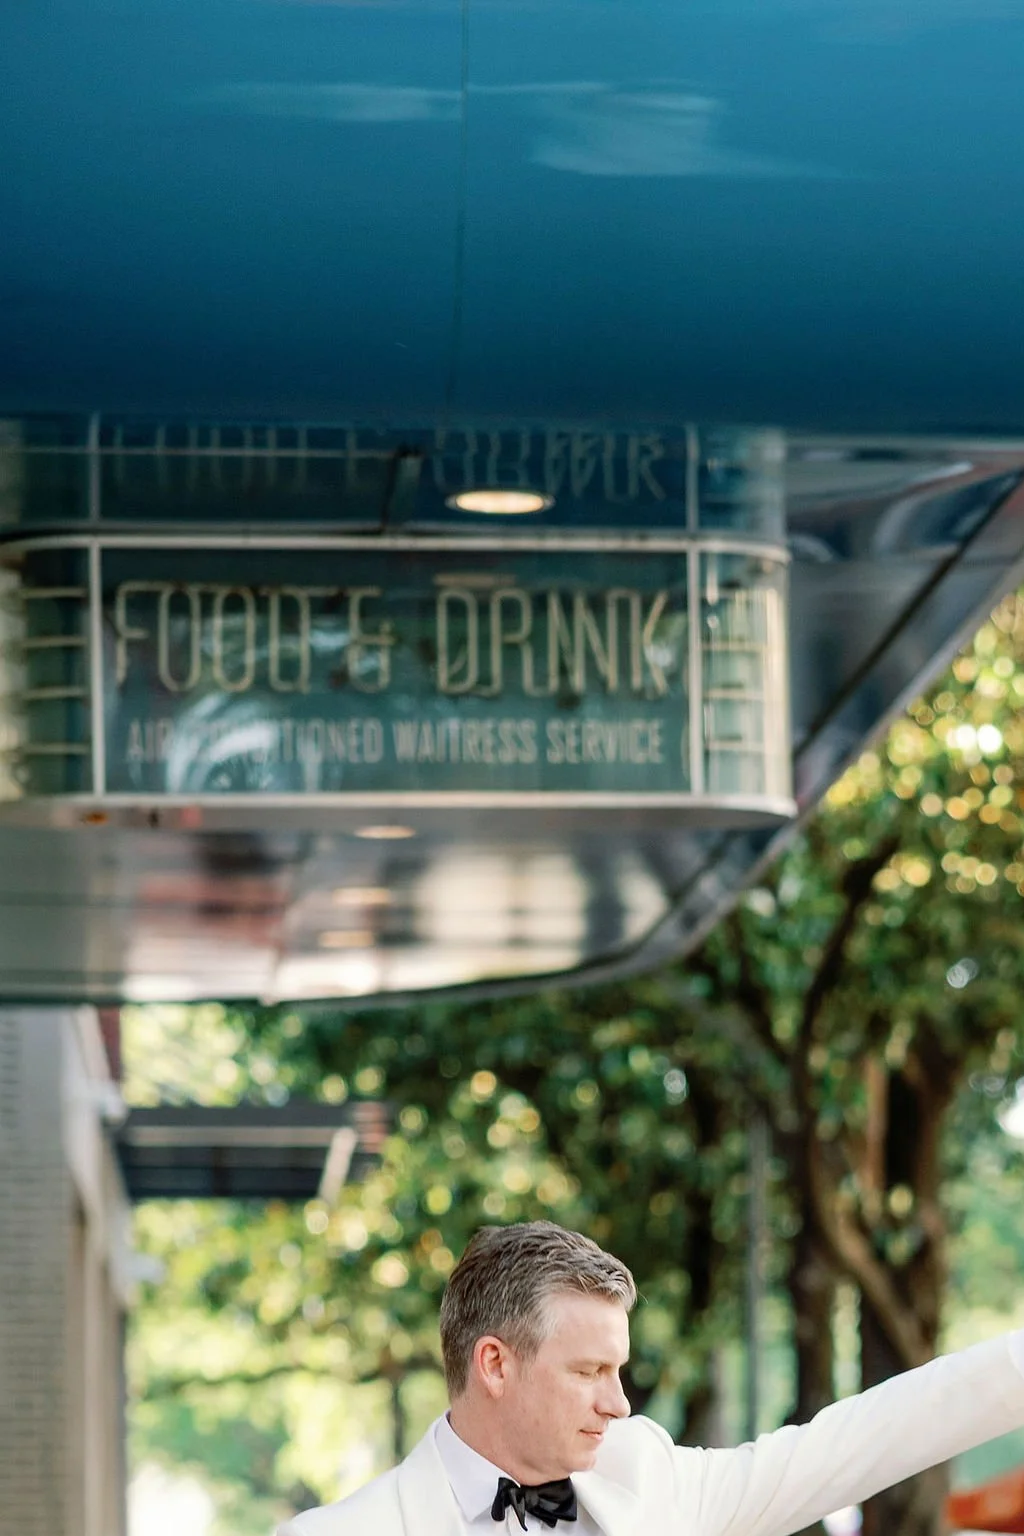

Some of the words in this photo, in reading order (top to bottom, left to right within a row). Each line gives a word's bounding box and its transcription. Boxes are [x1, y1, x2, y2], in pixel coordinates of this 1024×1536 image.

[115, 581, 312, 694] FOOD
[433, 576, 669, 697] DRINK
[392, 717, 538, 763] WAITRESS
[546, 718, 664, 763] SERVICE
